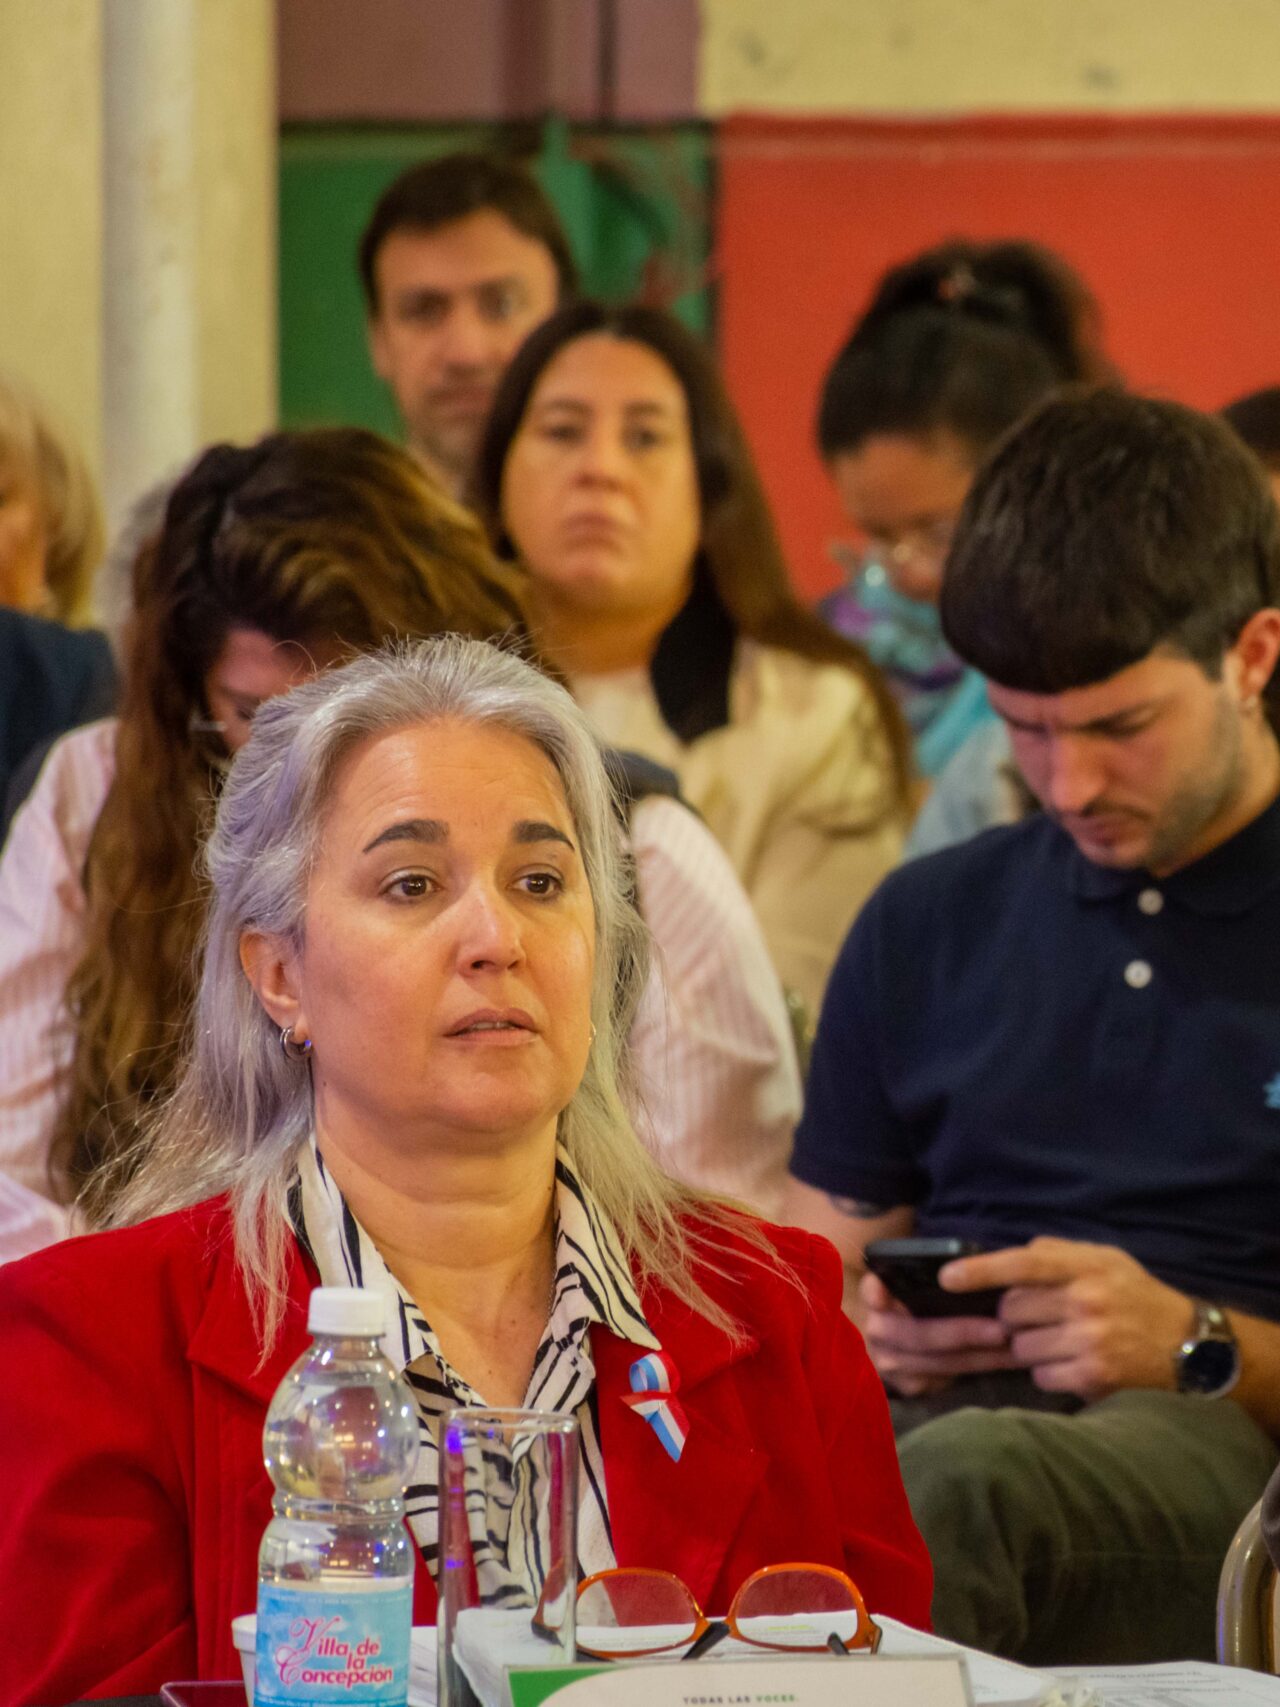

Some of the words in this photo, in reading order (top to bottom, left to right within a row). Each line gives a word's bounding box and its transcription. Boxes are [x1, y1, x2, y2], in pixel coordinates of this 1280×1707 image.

[289, 1616, 349, 1656] Villa
[356, 1637, 380, 1655] de
[346, 1653, 365, 1670] la
